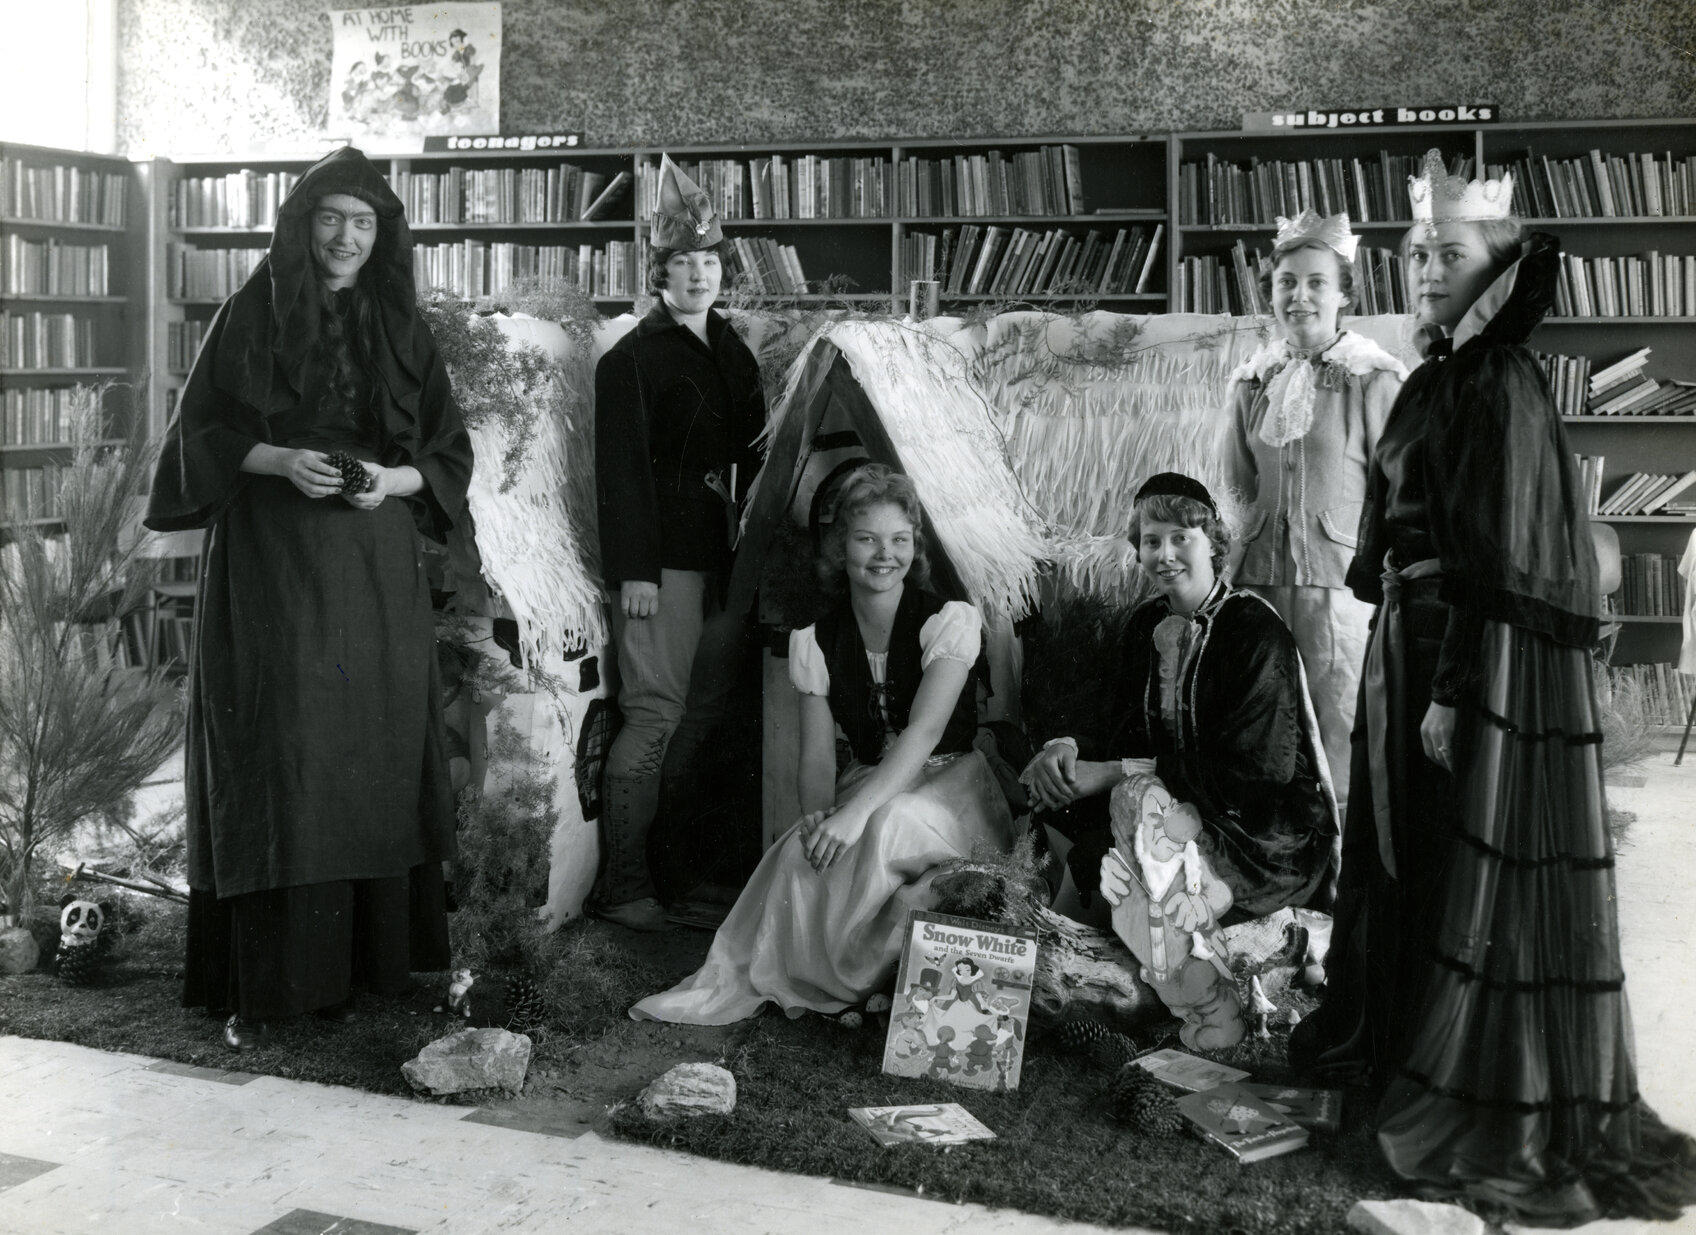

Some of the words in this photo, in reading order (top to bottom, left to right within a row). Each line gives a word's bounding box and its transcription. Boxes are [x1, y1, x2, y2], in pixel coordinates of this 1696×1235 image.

[343, 11, 361, 26] AT
[371, 8, 414, 25] HOME
[367, 25, 408, 42] WITH
[401, 41, 447, 59] BOOKS
[1272, 109, 1385, 128] subject
[1397, 106, 1492, 122] books
[448, 135, 578, 150] teenagers
[922, 923, 974, 948] Snow
[976, 935, 1027, 957] White
[934, 945, 949, 953] and
[950, 947, 963, 955] the
[965, 950, 987, 959] Seven
[989, 954, 1015, 964] Dwarfs
